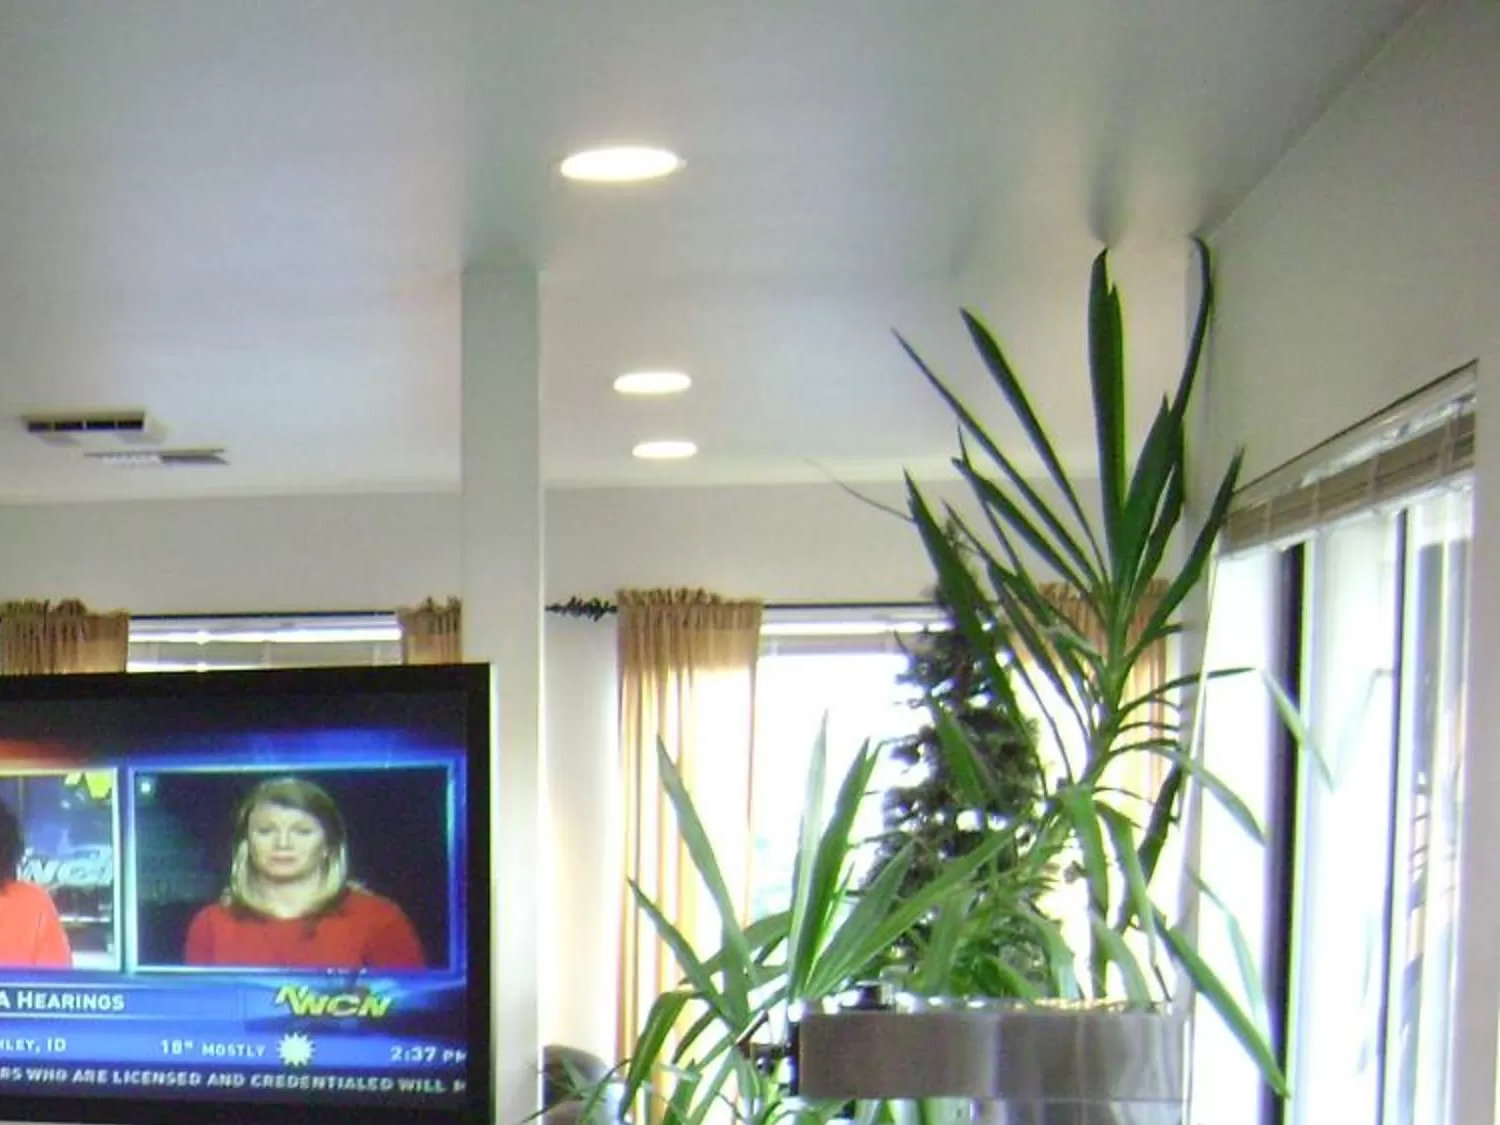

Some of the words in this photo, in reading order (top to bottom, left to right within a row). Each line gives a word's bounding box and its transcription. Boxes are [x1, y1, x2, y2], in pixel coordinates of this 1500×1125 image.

[17, 990, 125, 1011] HEARINGS
[275, 985, 392, 1017] NWCN
[201, 1042, 266, 1057] MOSTLY
[25, 1067, 69, 1083] WHO
[72, 1068, 108, 1085] ARE
[206, 1072, 246, 1088] AND
[396, 1077, 446, 1094] WILL
